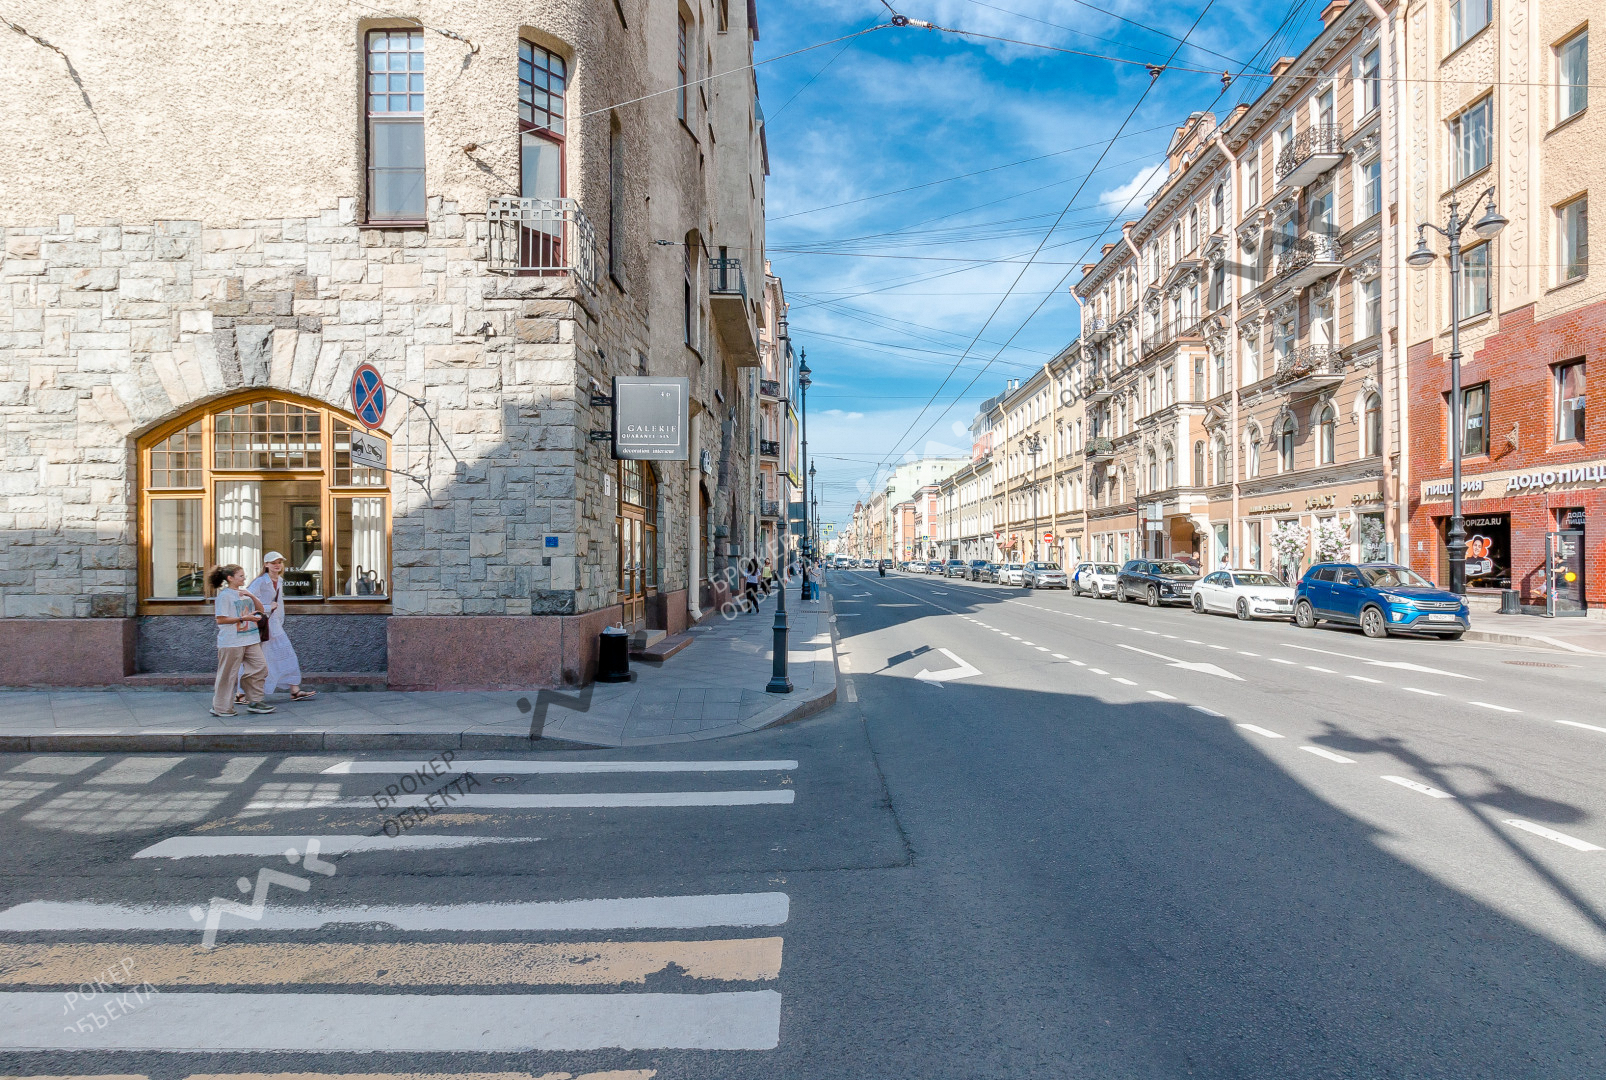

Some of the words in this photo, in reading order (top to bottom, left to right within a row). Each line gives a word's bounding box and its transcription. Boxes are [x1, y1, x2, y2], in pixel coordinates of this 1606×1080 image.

[627, 424, 677, 432] GALERIE
[1426, 479, 1485, 496] ПИЦЦРИЯ
[1506, 471, 1557, 492] ДОДО
